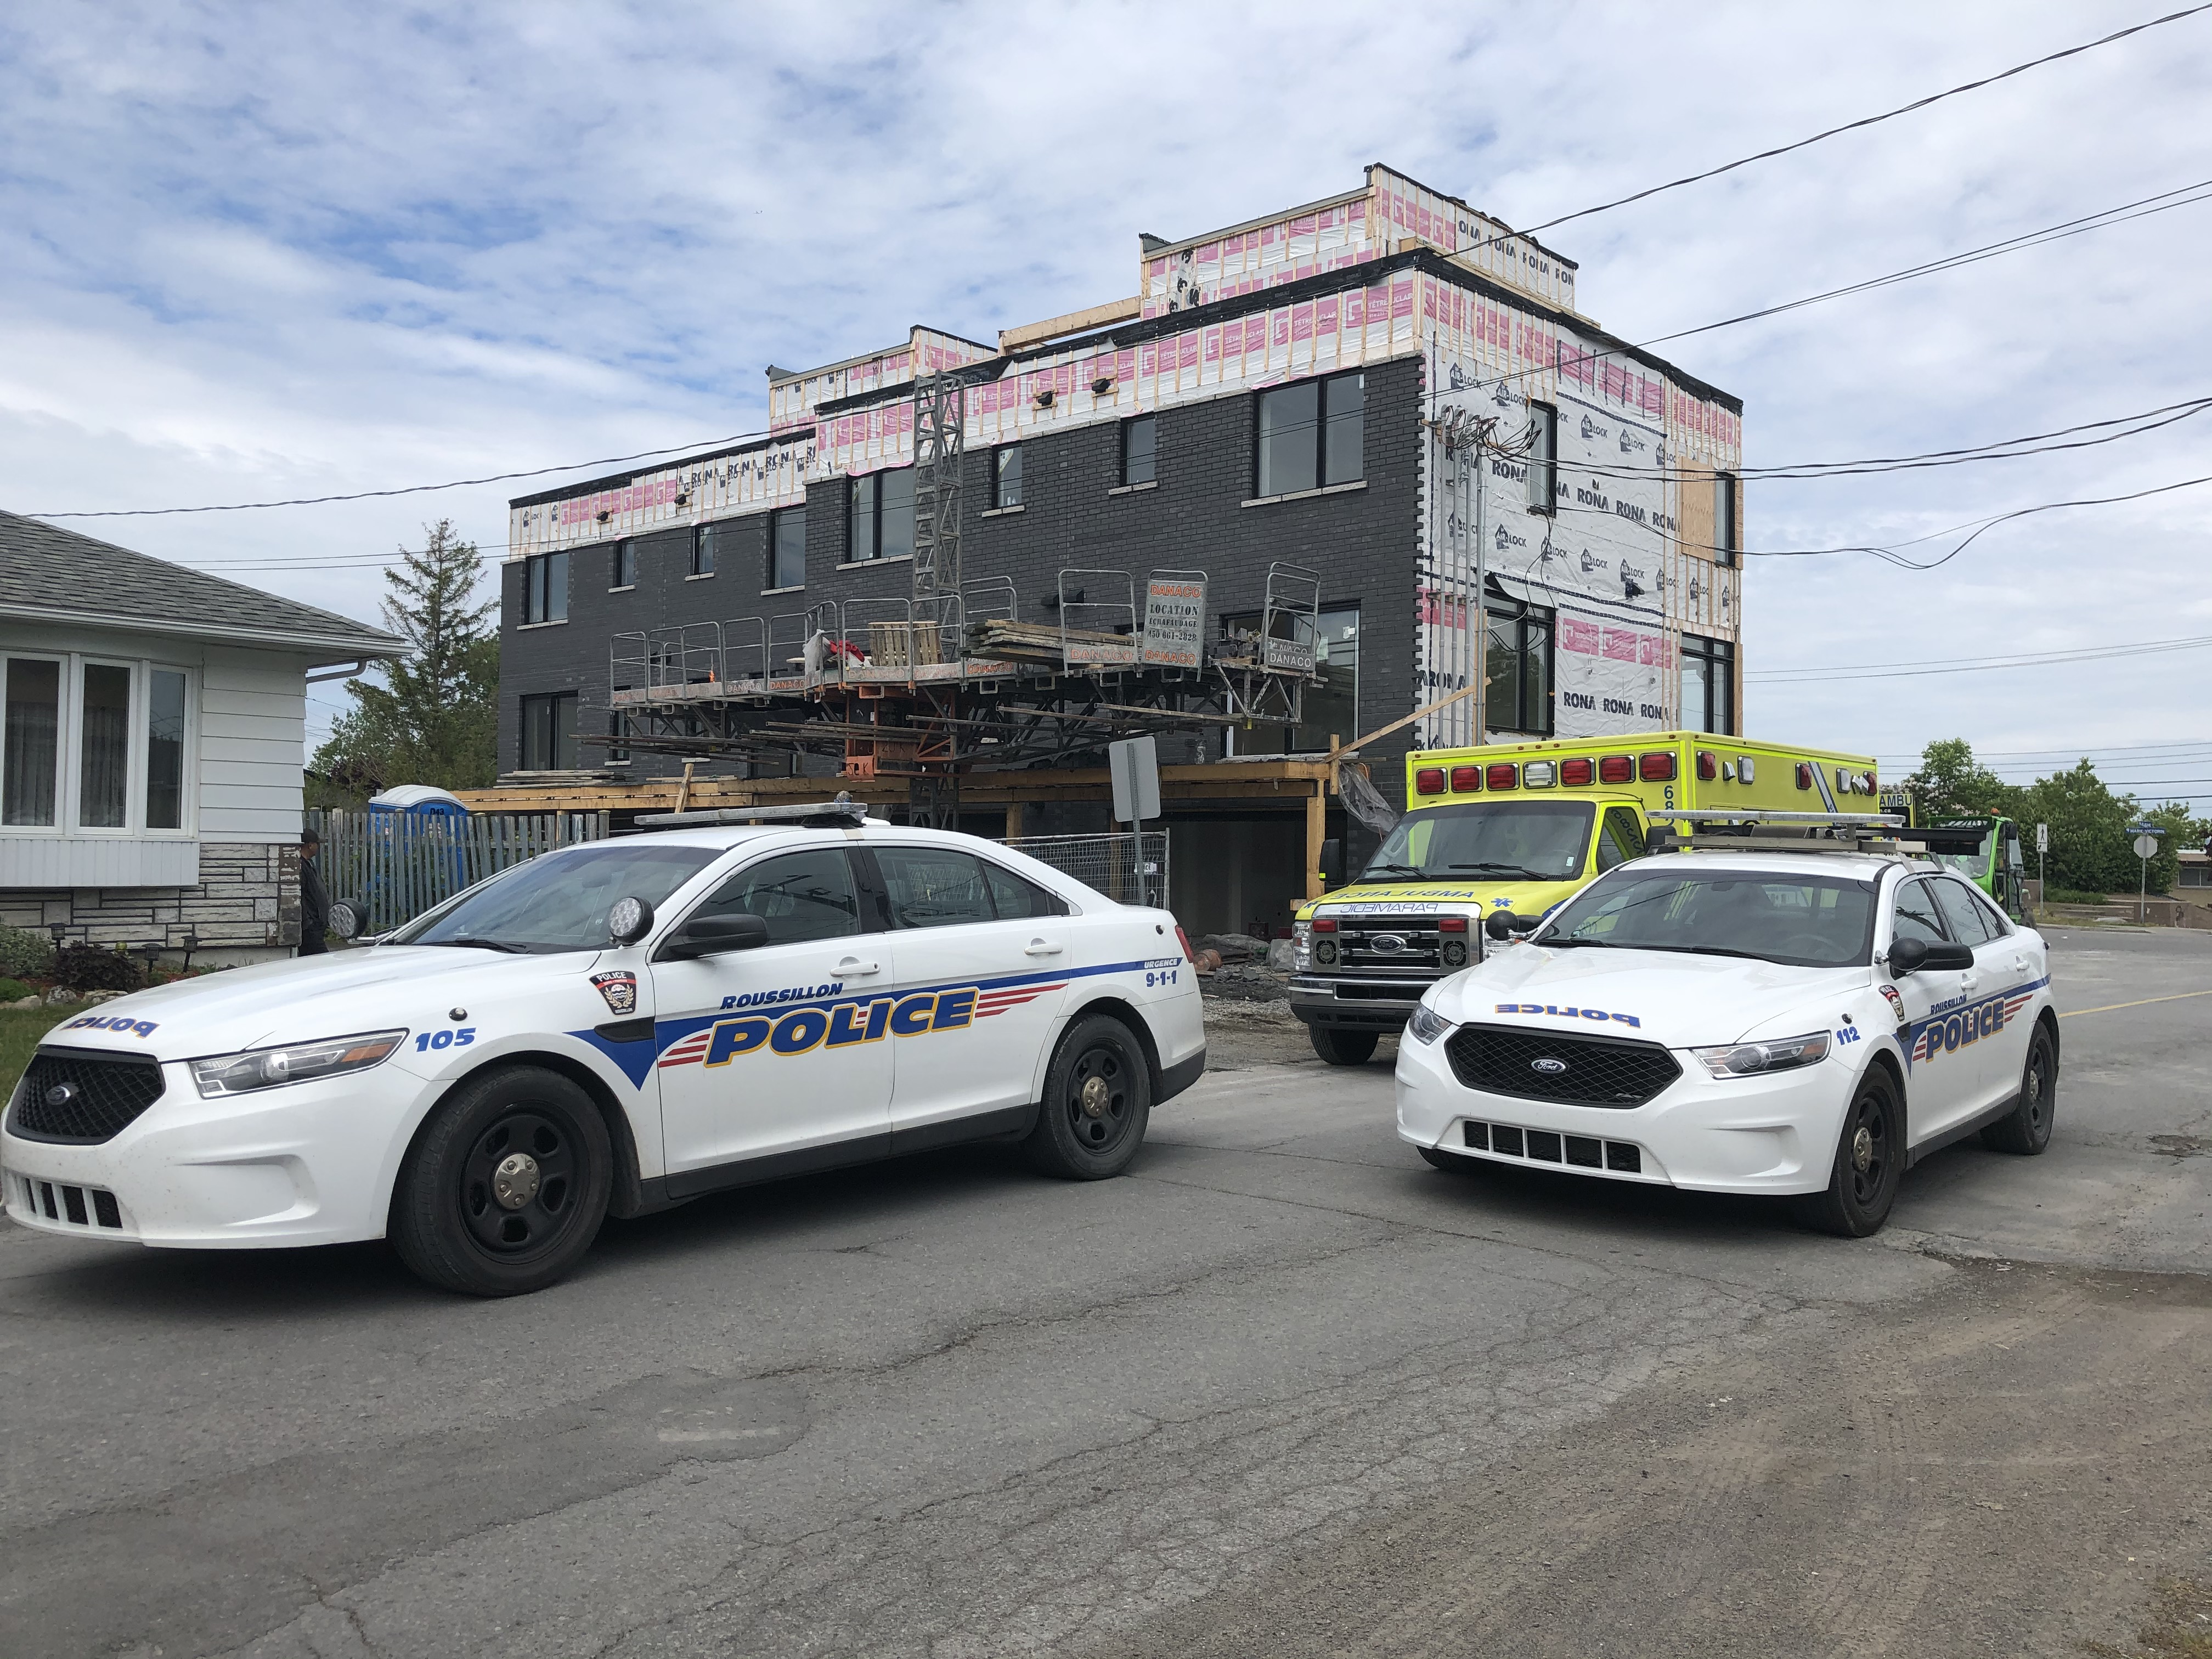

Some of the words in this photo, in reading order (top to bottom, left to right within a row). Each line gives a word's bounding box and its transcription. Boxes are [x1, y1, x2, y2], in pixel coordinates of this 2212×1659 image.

[1577, 487, 1609, 511] RONA
[1617, 500, 1646, 522] RONA
[1151, 584, 1201, 598] DANACO
[1150, 604, 1199, 616] LOCATION
[1071, 648, 1133, 661] DANACO
[1145, 650, 1196, 665] DANACO
[1269, 652, 1311, 668] DANACO
[967, 661, 1013, 674] DANACO
[770, 679, 805, 690] DANACO
[1564, 691, 1596, 710] RONA
[1603, 697, 1634, 716] RONA
[1144, 958, 1178, 969] URGENCE
[596, 972, 627, 982] POLICE
[1146, 970, 1177, 988] 9-1-1
[719, 983, 843, 1011] ROUSSILLON
[1930, 994, 1967, 1015] ROUSSILLON
[704, 986, 980, 1069] POLICE
[1925, 996, 2005, 1064] POLICE
[415, 1027, 477, 1053] 105
[1836, 1026, 1861, 1046] 112
[1537, 1060, 1558, 1070] Ford
